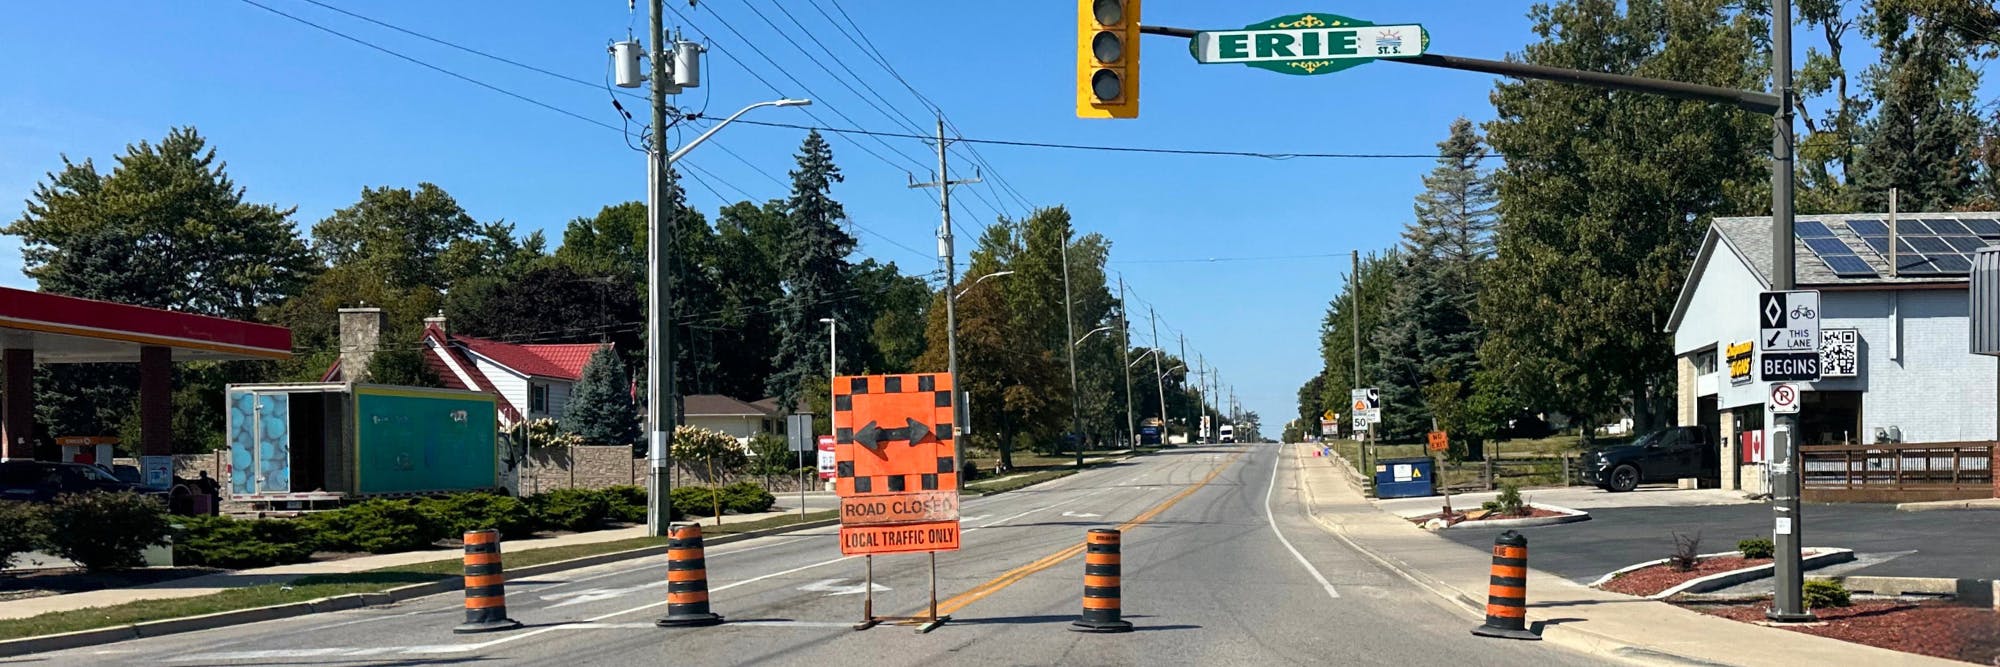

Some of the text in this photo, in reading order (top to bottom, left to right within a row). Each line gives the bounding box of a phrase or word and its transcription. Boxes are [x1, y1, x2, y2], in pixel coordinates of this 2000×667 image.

[1219, 30, 1357, 59] ERIE
[1378, 45, 1401, 55] ST. S.
[1789, 329, 1809, 338] THIS
[1787, 338, 1811, 347] LANE
[1764, 359, 1817, 375] BEGINS
[1354, 417, 1366, 427] 50
[1431, 441, 1446, 449] EXIT
[845, 498, 953, 516] ROAD CLOSED
[845, 528, 954, 548] LOCAL TRAFFIC ONLY
